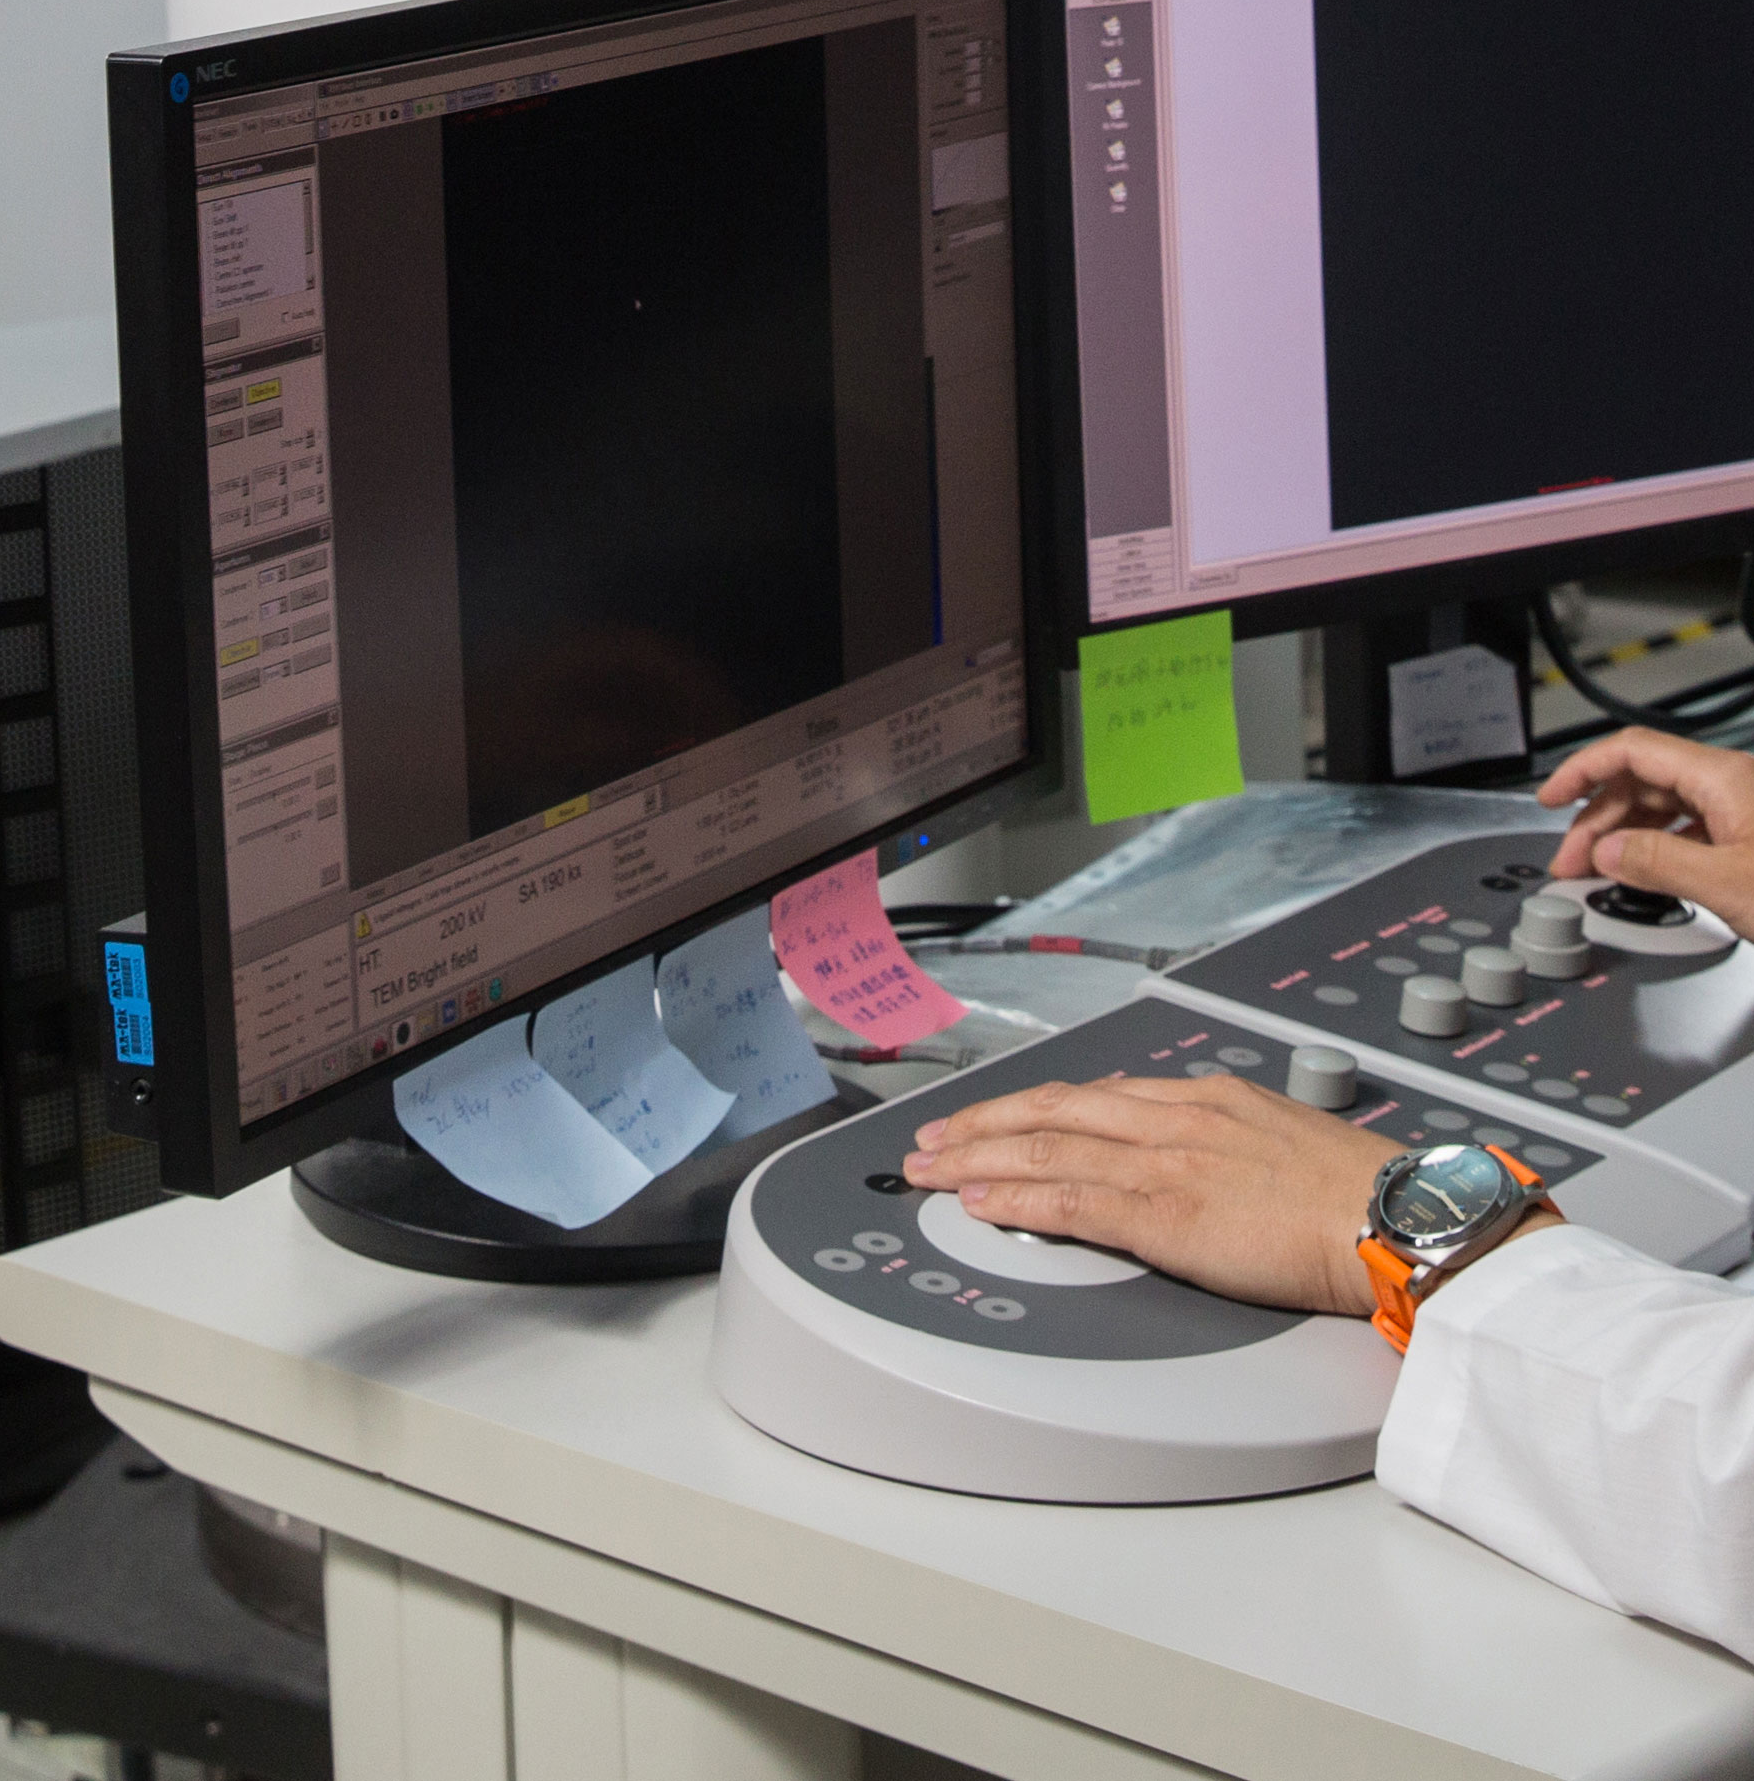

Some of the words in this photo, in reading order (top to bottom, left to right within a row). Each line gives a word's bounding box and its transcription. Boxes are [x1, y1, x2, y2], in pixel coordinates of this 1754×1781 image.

[196, 58, 238, 84] NEC
[439, 911, 466, 941] 200
[467, 900, 487, 927] kV
[518, 881, 539, 905] SA
[541, 869, 566, 896] 190
[370, 977, 405, 1008] TEM
[407, 957, 449, 995] Bright
[450, 946, 479, 975] field
